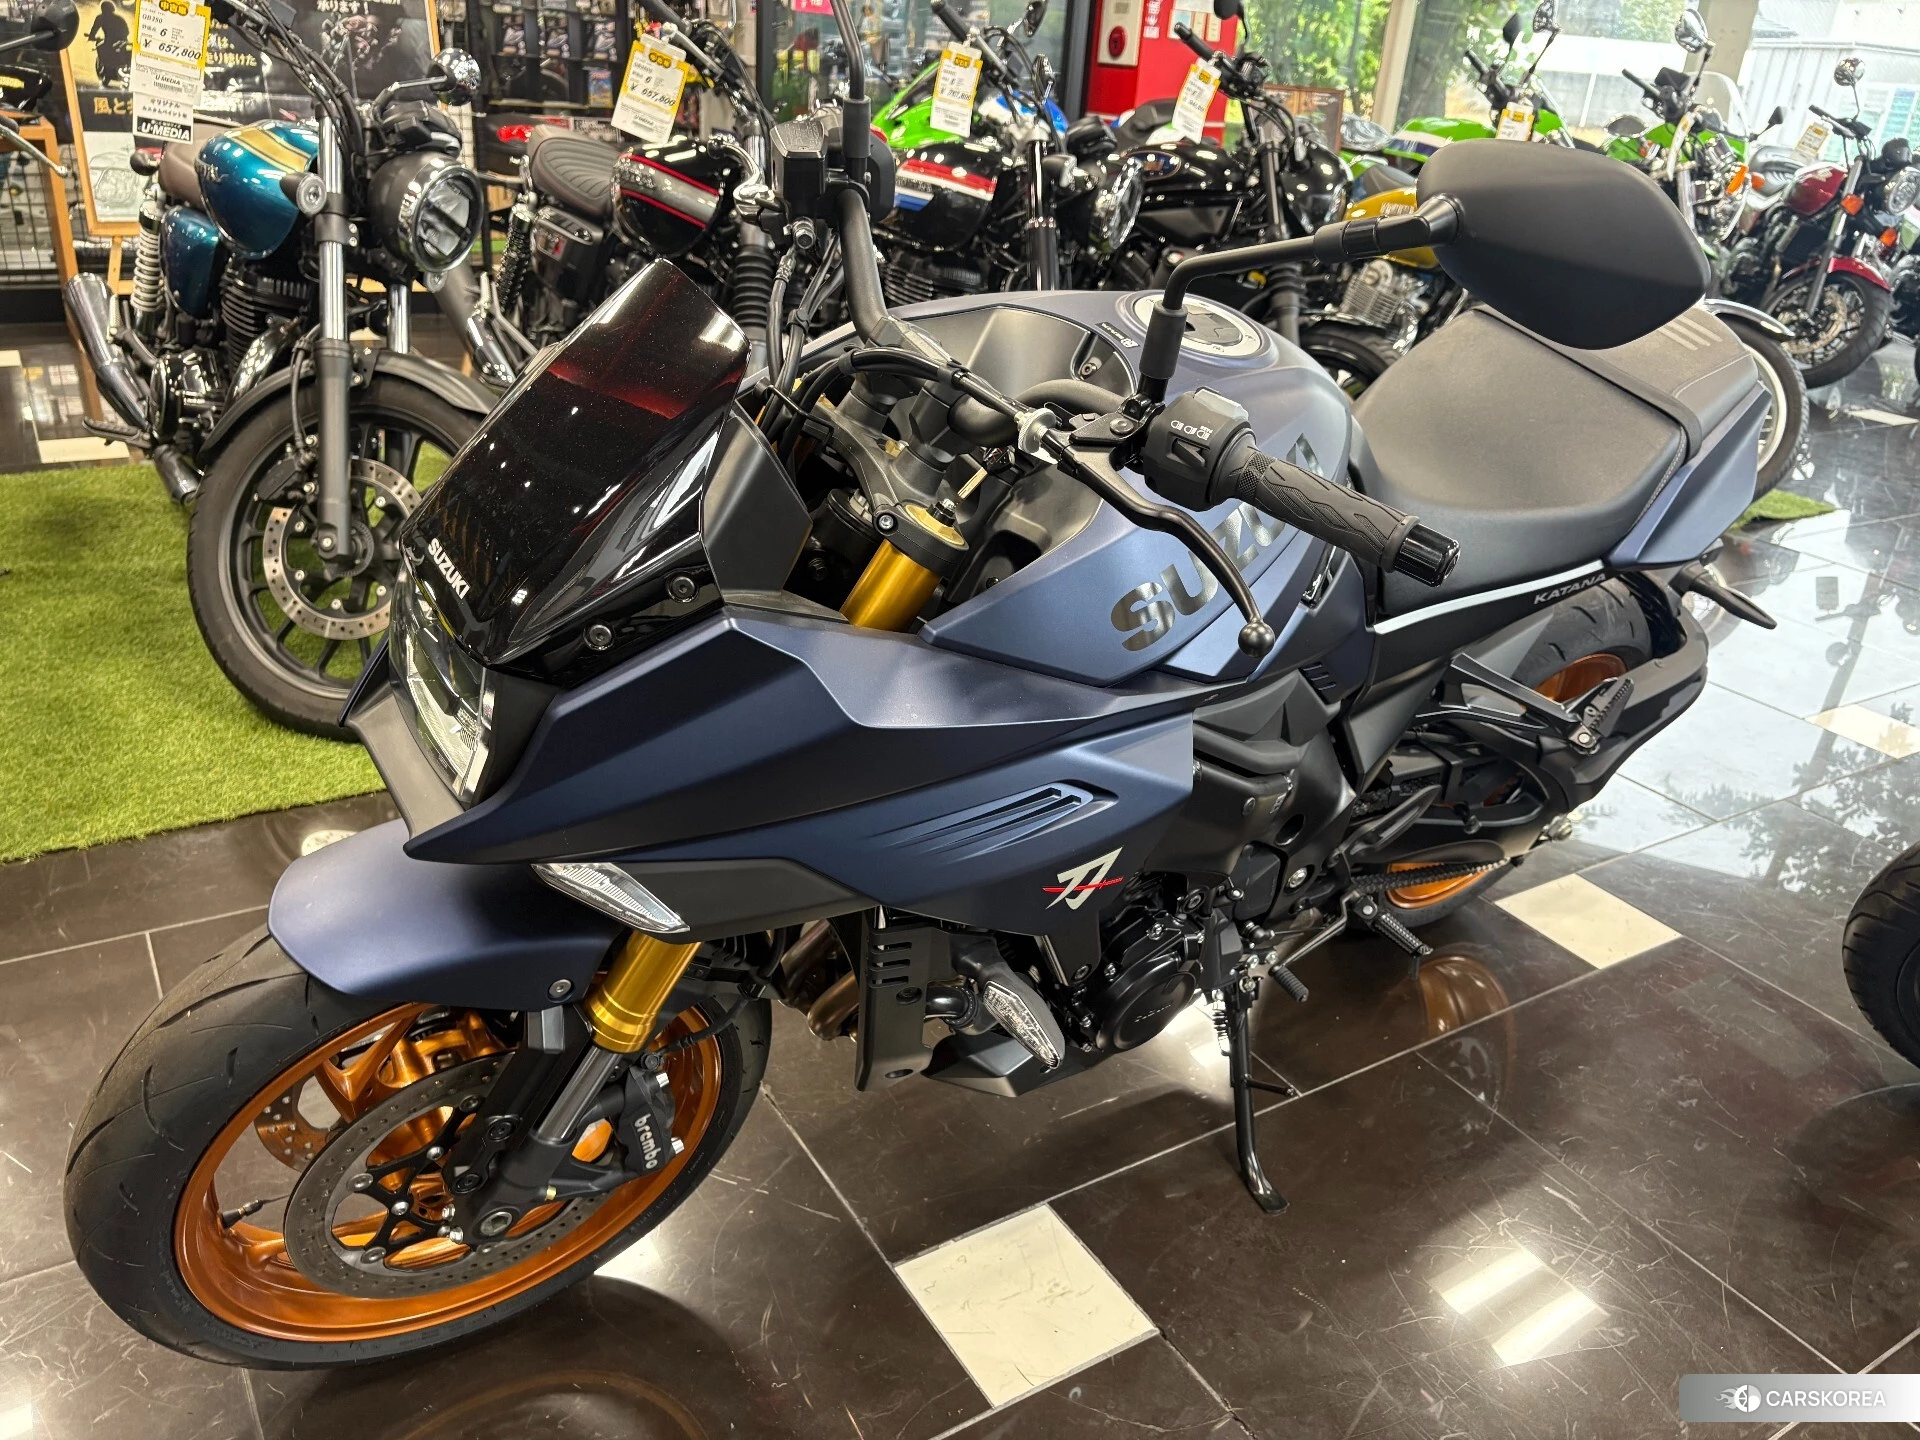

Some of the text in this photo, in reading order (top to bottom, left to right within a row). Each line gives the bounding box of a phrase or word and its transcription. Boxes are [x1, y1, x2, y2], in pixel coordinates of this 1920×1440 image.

[160, 28, 168, 37] 6
[158, 42, 202, 60] 657,800
[427, 537, 471, 600] SUZUKI
[1533, 573, 1607, 605] KATANA
[634, 1113, 662, 1169] brembo
